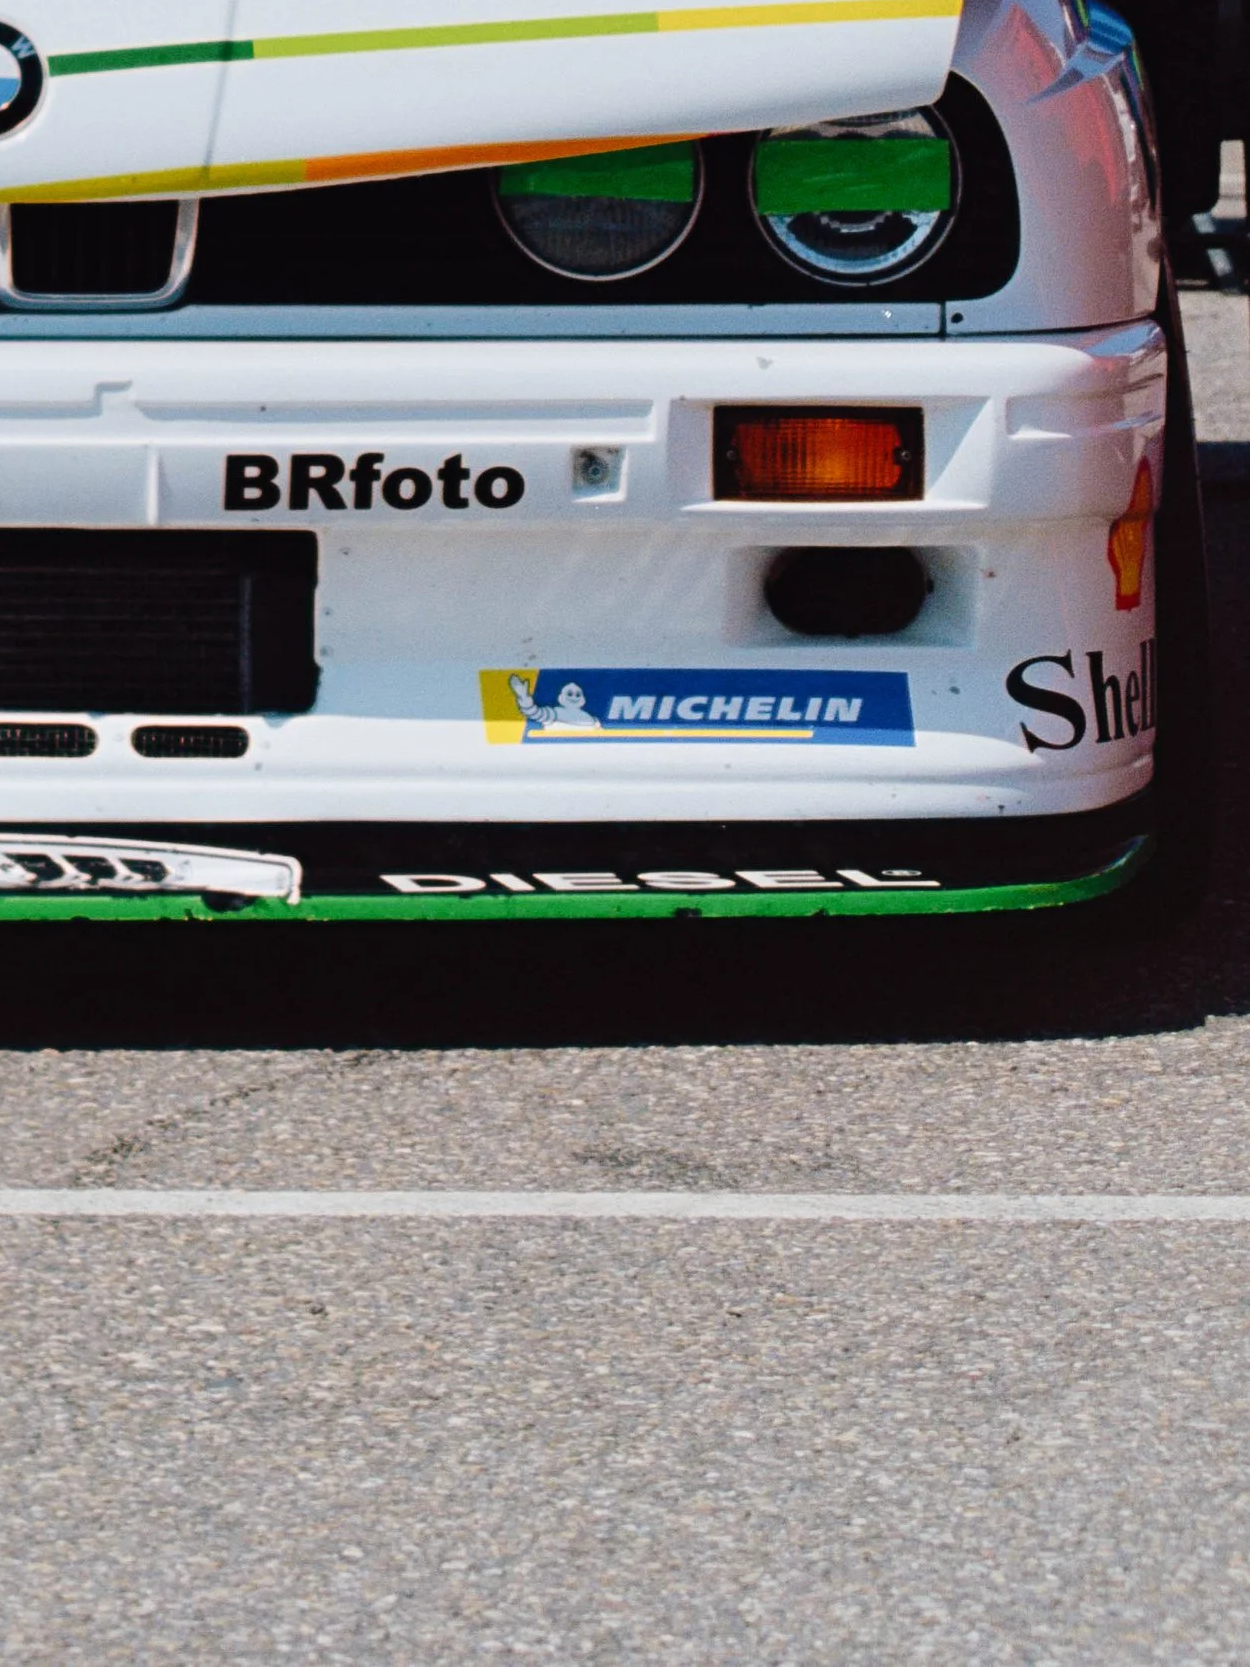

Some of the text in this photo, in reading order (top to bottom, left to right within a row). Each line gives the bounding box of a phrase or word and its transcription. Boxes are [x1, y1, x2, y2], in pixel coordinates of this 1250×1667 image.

[224, 452, 526, 511] BRfoto
[608, 694, 863, 722] MICHELIN
[1005, 637, 1156, 753] Shell
[379, 868, 942, 893] DIESEL
